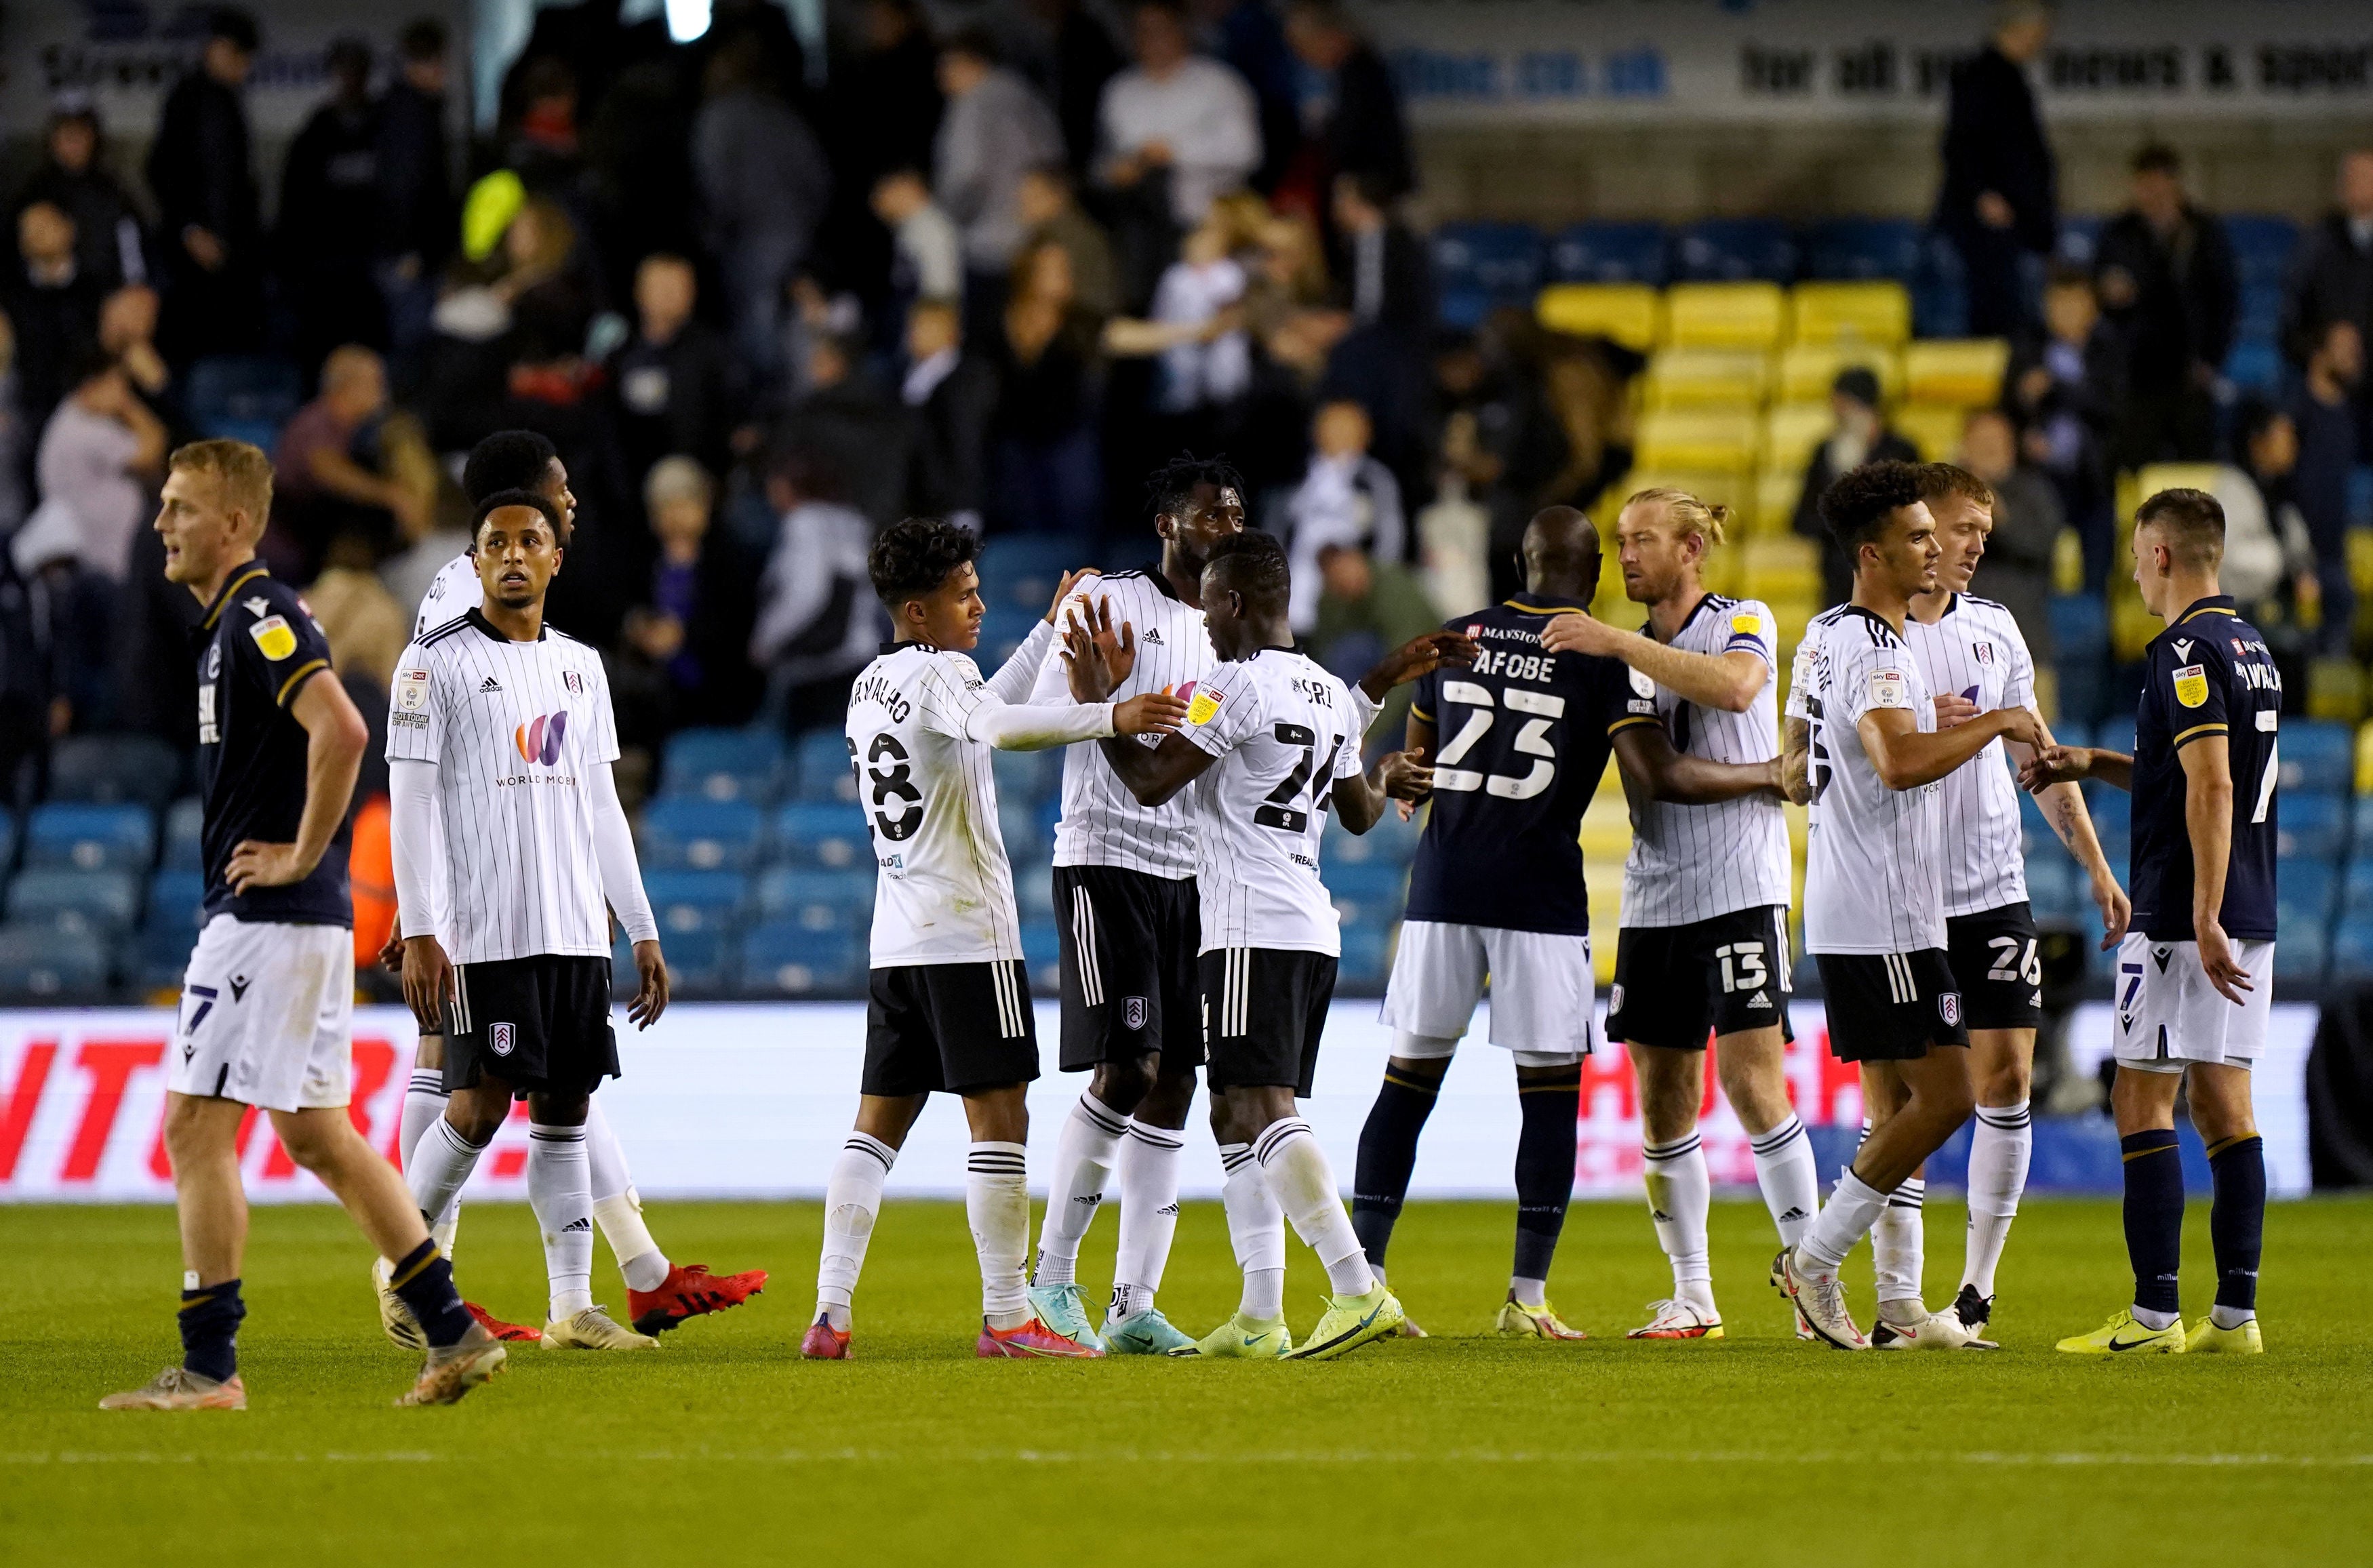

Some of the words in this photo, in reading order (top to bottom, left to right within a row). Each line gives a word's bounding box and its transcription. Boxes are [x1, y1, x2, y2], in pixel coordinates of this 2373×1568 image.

[1142, 636, 1165, 646] adidas
[1473, 649, 1557, 683] AFOBE
[479, 685, 503, 693] adidas
[848, 677, 911, 725] RVALHO
[1210, 691, 1222, 701] bet
[407, 715, 428, 723] TODAY
[1433, 680, 1566, 800] 23
[496, 776, 541, 787] WORLD
[546, 775, 576, 786] MOBI
[1716, 941, 1768, 993] 13
[1987, 936, 2041, 986] 26
[2119, 963, 2142, 1011] 7
[179, 984, 218, 1037] 7
[1746, 1000, 1773, 1009] adidas
[2157, 1273, 2178, 1281] millw
[2229, 1267, 2258, 1278] millwa
